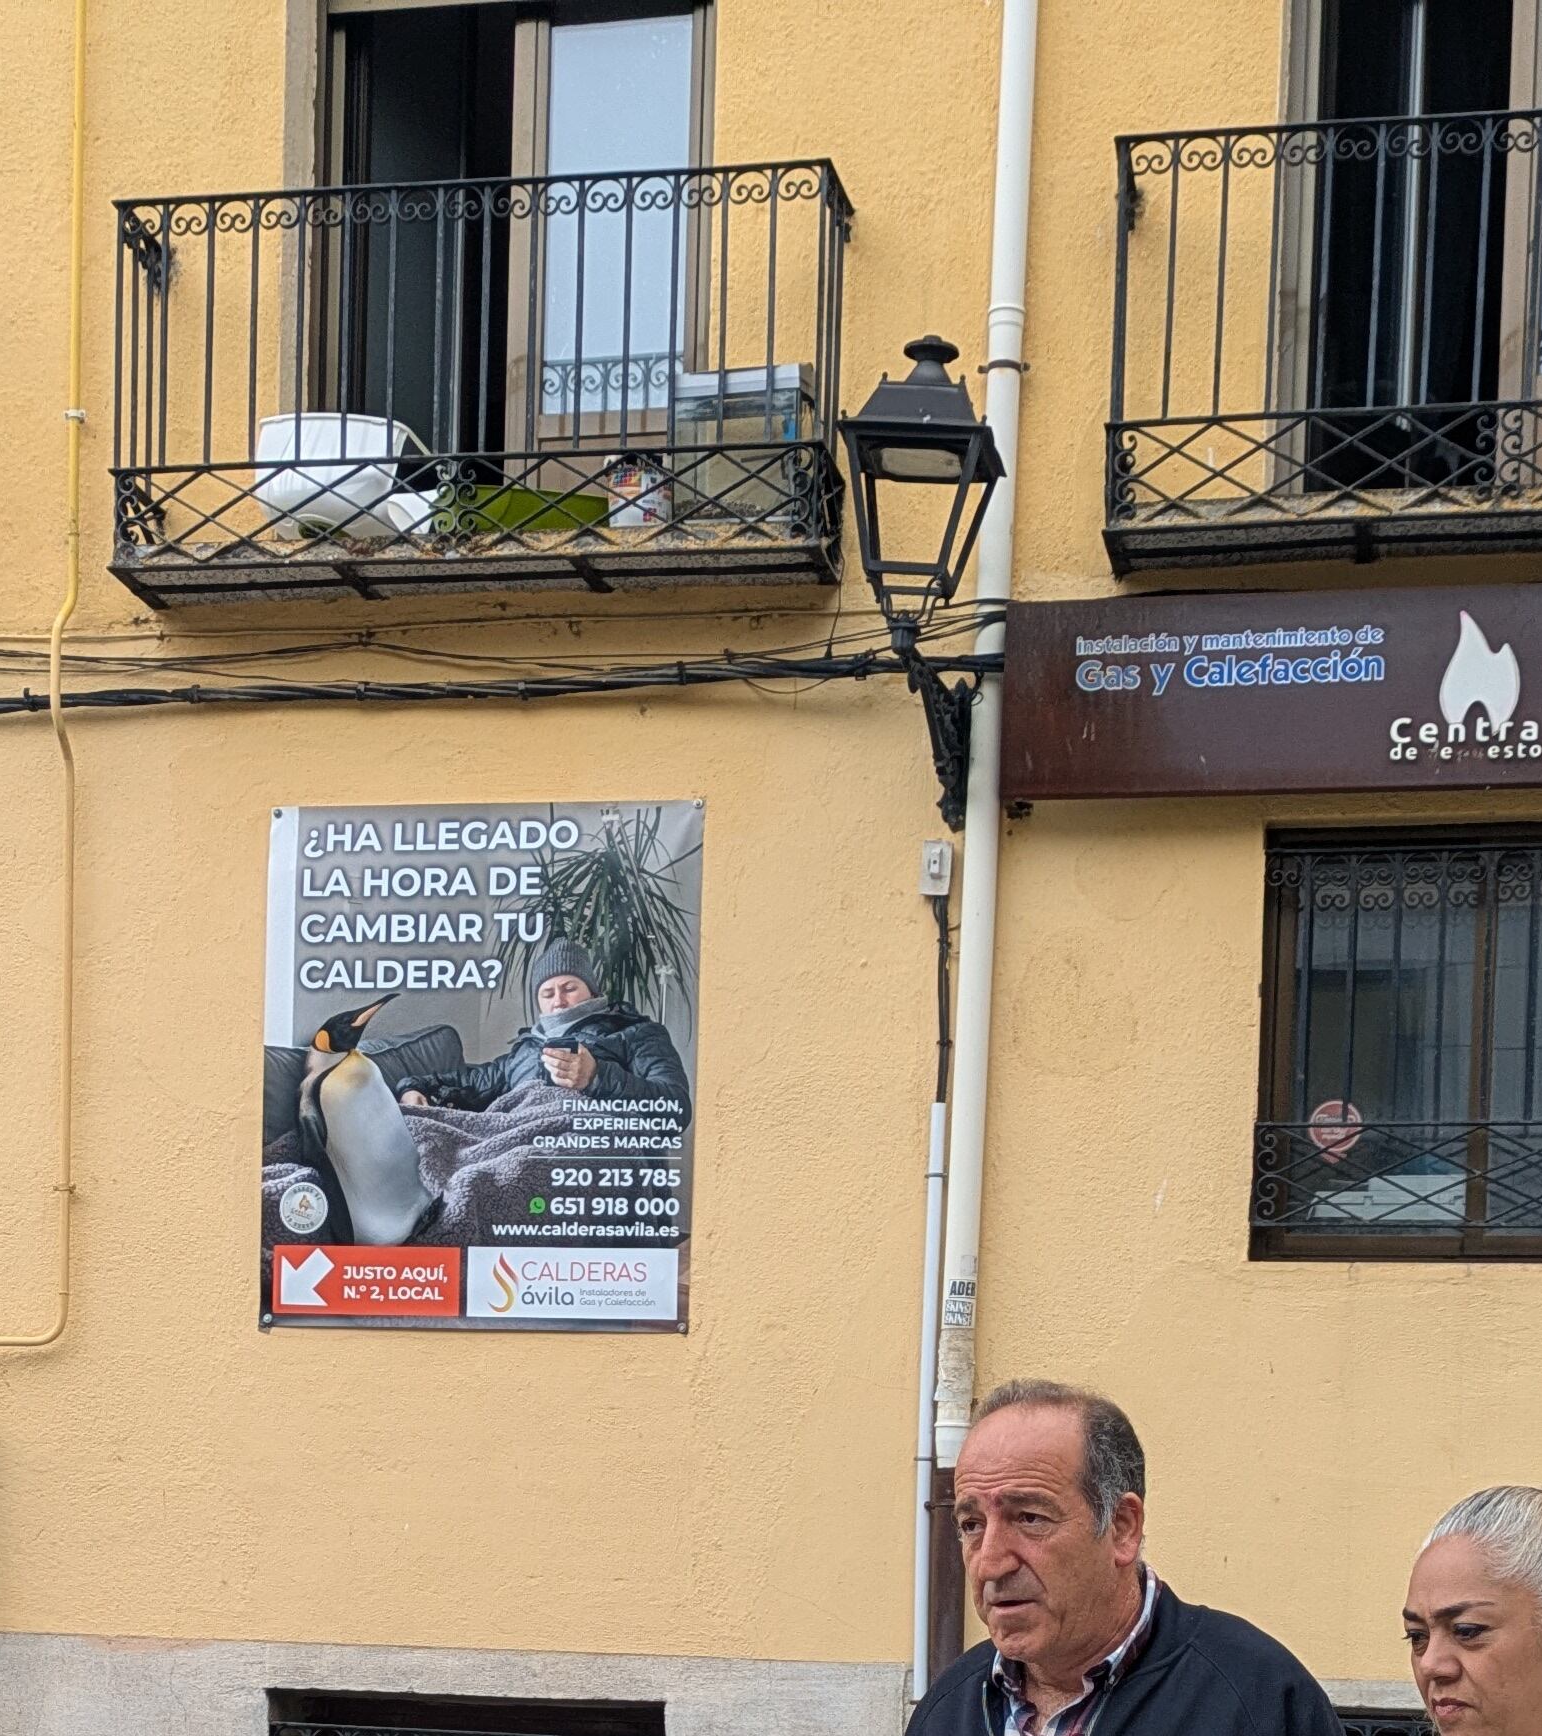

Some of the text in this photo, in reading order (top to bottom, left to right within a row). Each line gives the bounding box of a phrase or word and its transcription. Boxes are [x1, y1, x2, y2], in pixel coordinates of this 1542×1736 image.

[1075, 626, 1385, 656] instalación y mantenimiento de
[1075, 647, 1385, 695] Gas y Calefacción
[1389, 742, 1419, 761] de
[303, 819, 579, 859] ¿HA LLEGADO
[303, 867, 543, 898] LA HORA DE
[300, 914, 545, 943] CAMBIAR TU
[299, 960, 503, 990] CALDERA?
[562, 1097, 684, 1115] FINANCIACIÓN,
[572, 1118, 683, 1133] EXPERIENCIA,
[532, 1136, 682, 1149] GRANDES MARCAS
[551, 1168, 681, 1187] 920 213 785
[549, 1197, 680, 1216] 651 918 000
[492, 1222, 680, 1238] www.calderasavila.es
[343, 1264, 448, 1283] JUSTO AQUÍ,
[521, 1261, 647, 1282] CALDERAS
[370, 1286, 384, 1301] 2,
[388, 1287, 444, 1300] LOCAL
[521, 1285, 574, 1306] ávila
[579, 1288, 647, 1297] Instaladores de
[579, 1298, 596, 1306] Gas
[604, 1297, 656, 1306] Calefacción
